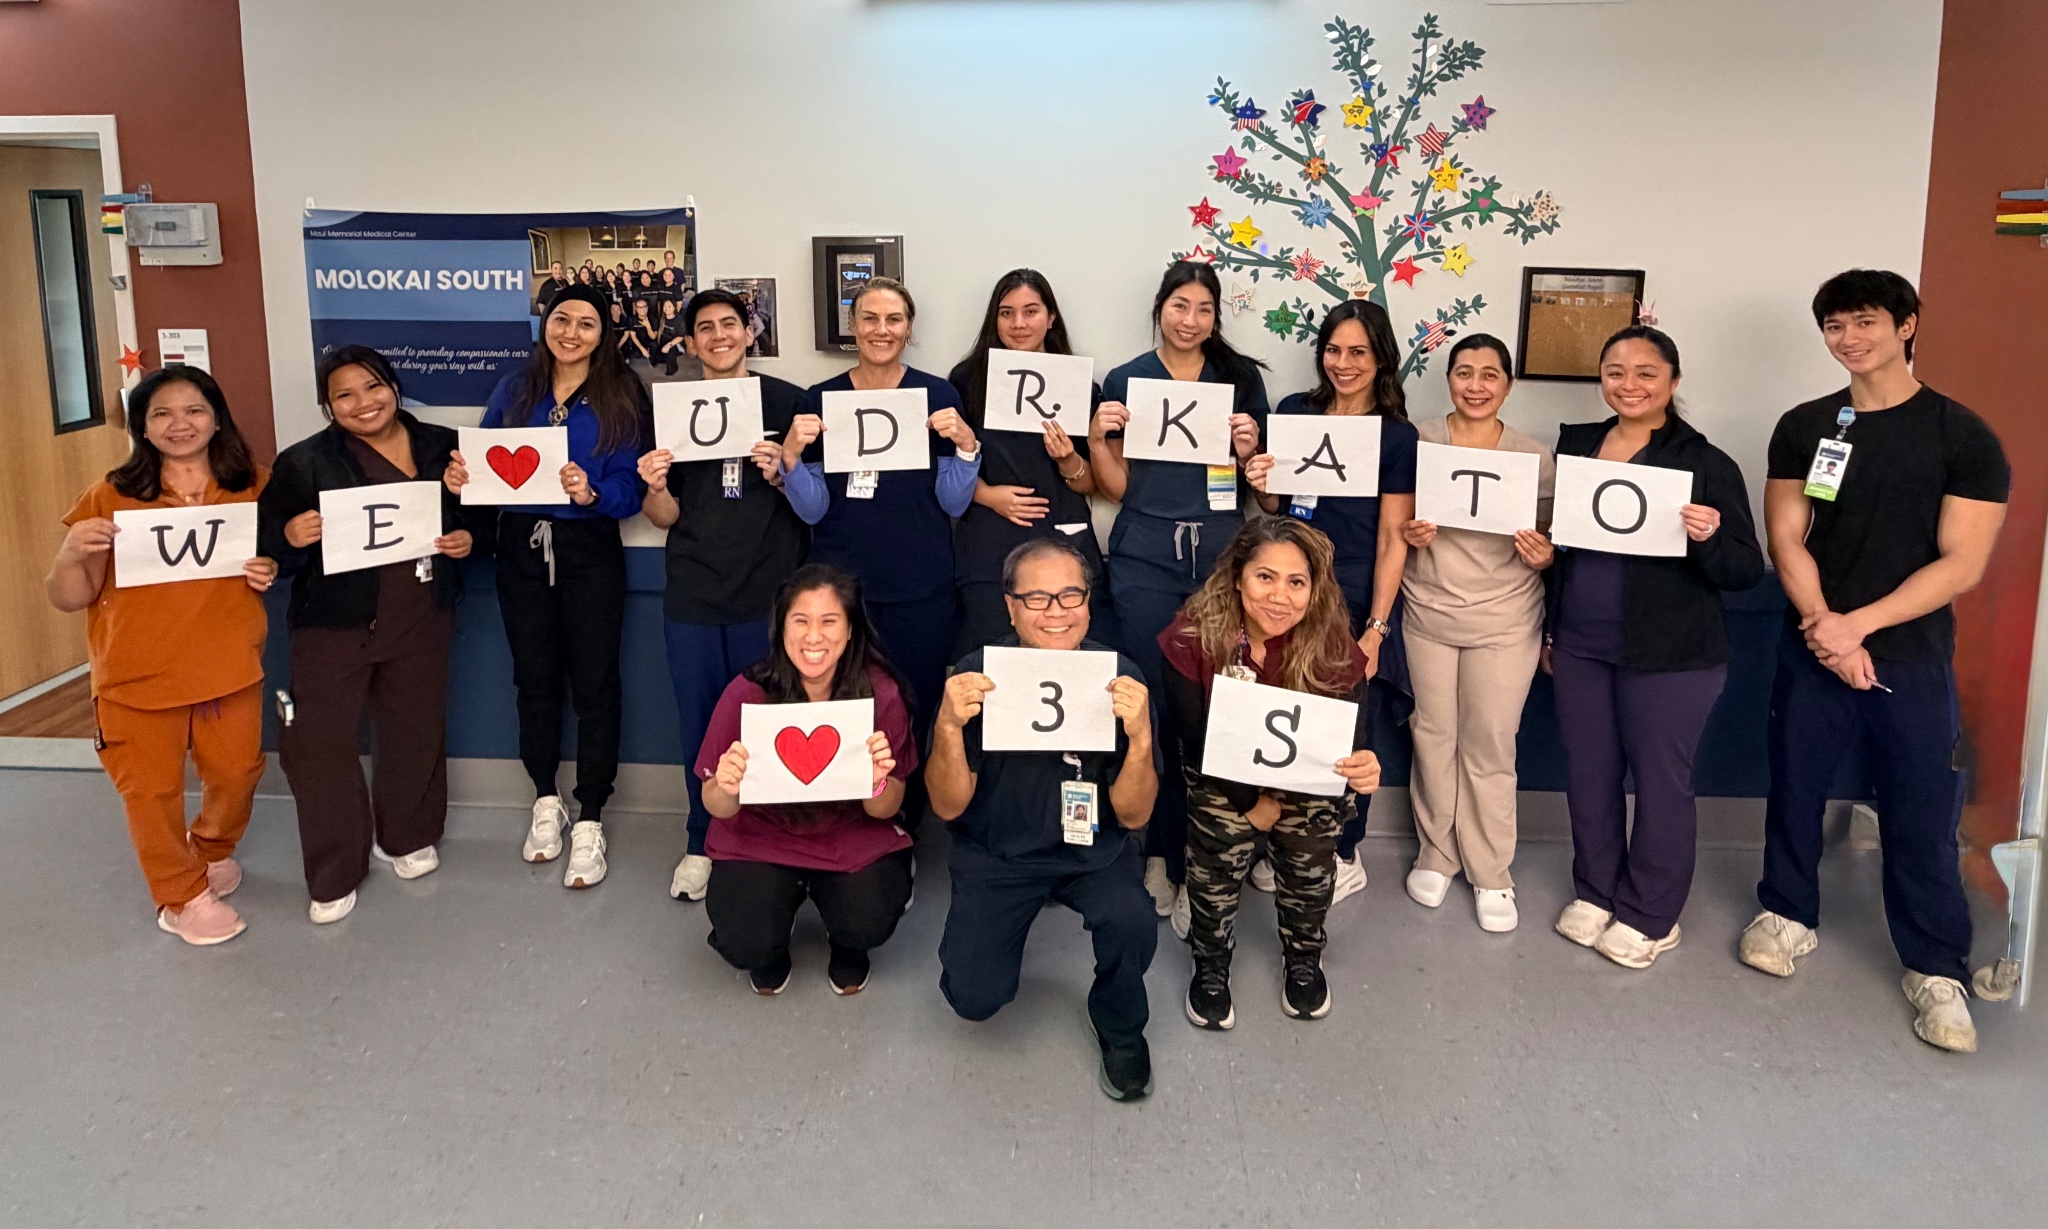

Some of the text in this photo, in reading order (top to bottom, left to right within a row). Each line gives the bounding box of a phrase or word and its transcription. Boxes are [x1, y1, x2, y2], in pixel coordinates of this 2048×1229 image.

[327, 230, 362, 238] Memorial
[315, 269, 523, 290] MOLOKAI SOUTH
[401, 359, 428, 374] during
[428, 362, 448, 374] your
[449, 361, 466, 374] stay
[467, 359, 486, 370] with
[408, 347, 416, 357] to
[416, 345, 455, 361] providing
[456, 348, 511, 360] compassionate
[511, 349, 530, 358] care
[689, 396, 730, 447] U
[854, 408, 899, 457] D
[1157, 397, 1199, 449] K
[1294, 432, 1347, 483] A
[724, 486, 740, 498] RN
[1450, 469, 1502, 518] T
[1592, 478, 1648, 535] O
[149, 518, 226, 568] W
[362, 503, 405, 551] E
[1031, 681, 1065, 733] 3
[1252, 704, 1302, 769] S
